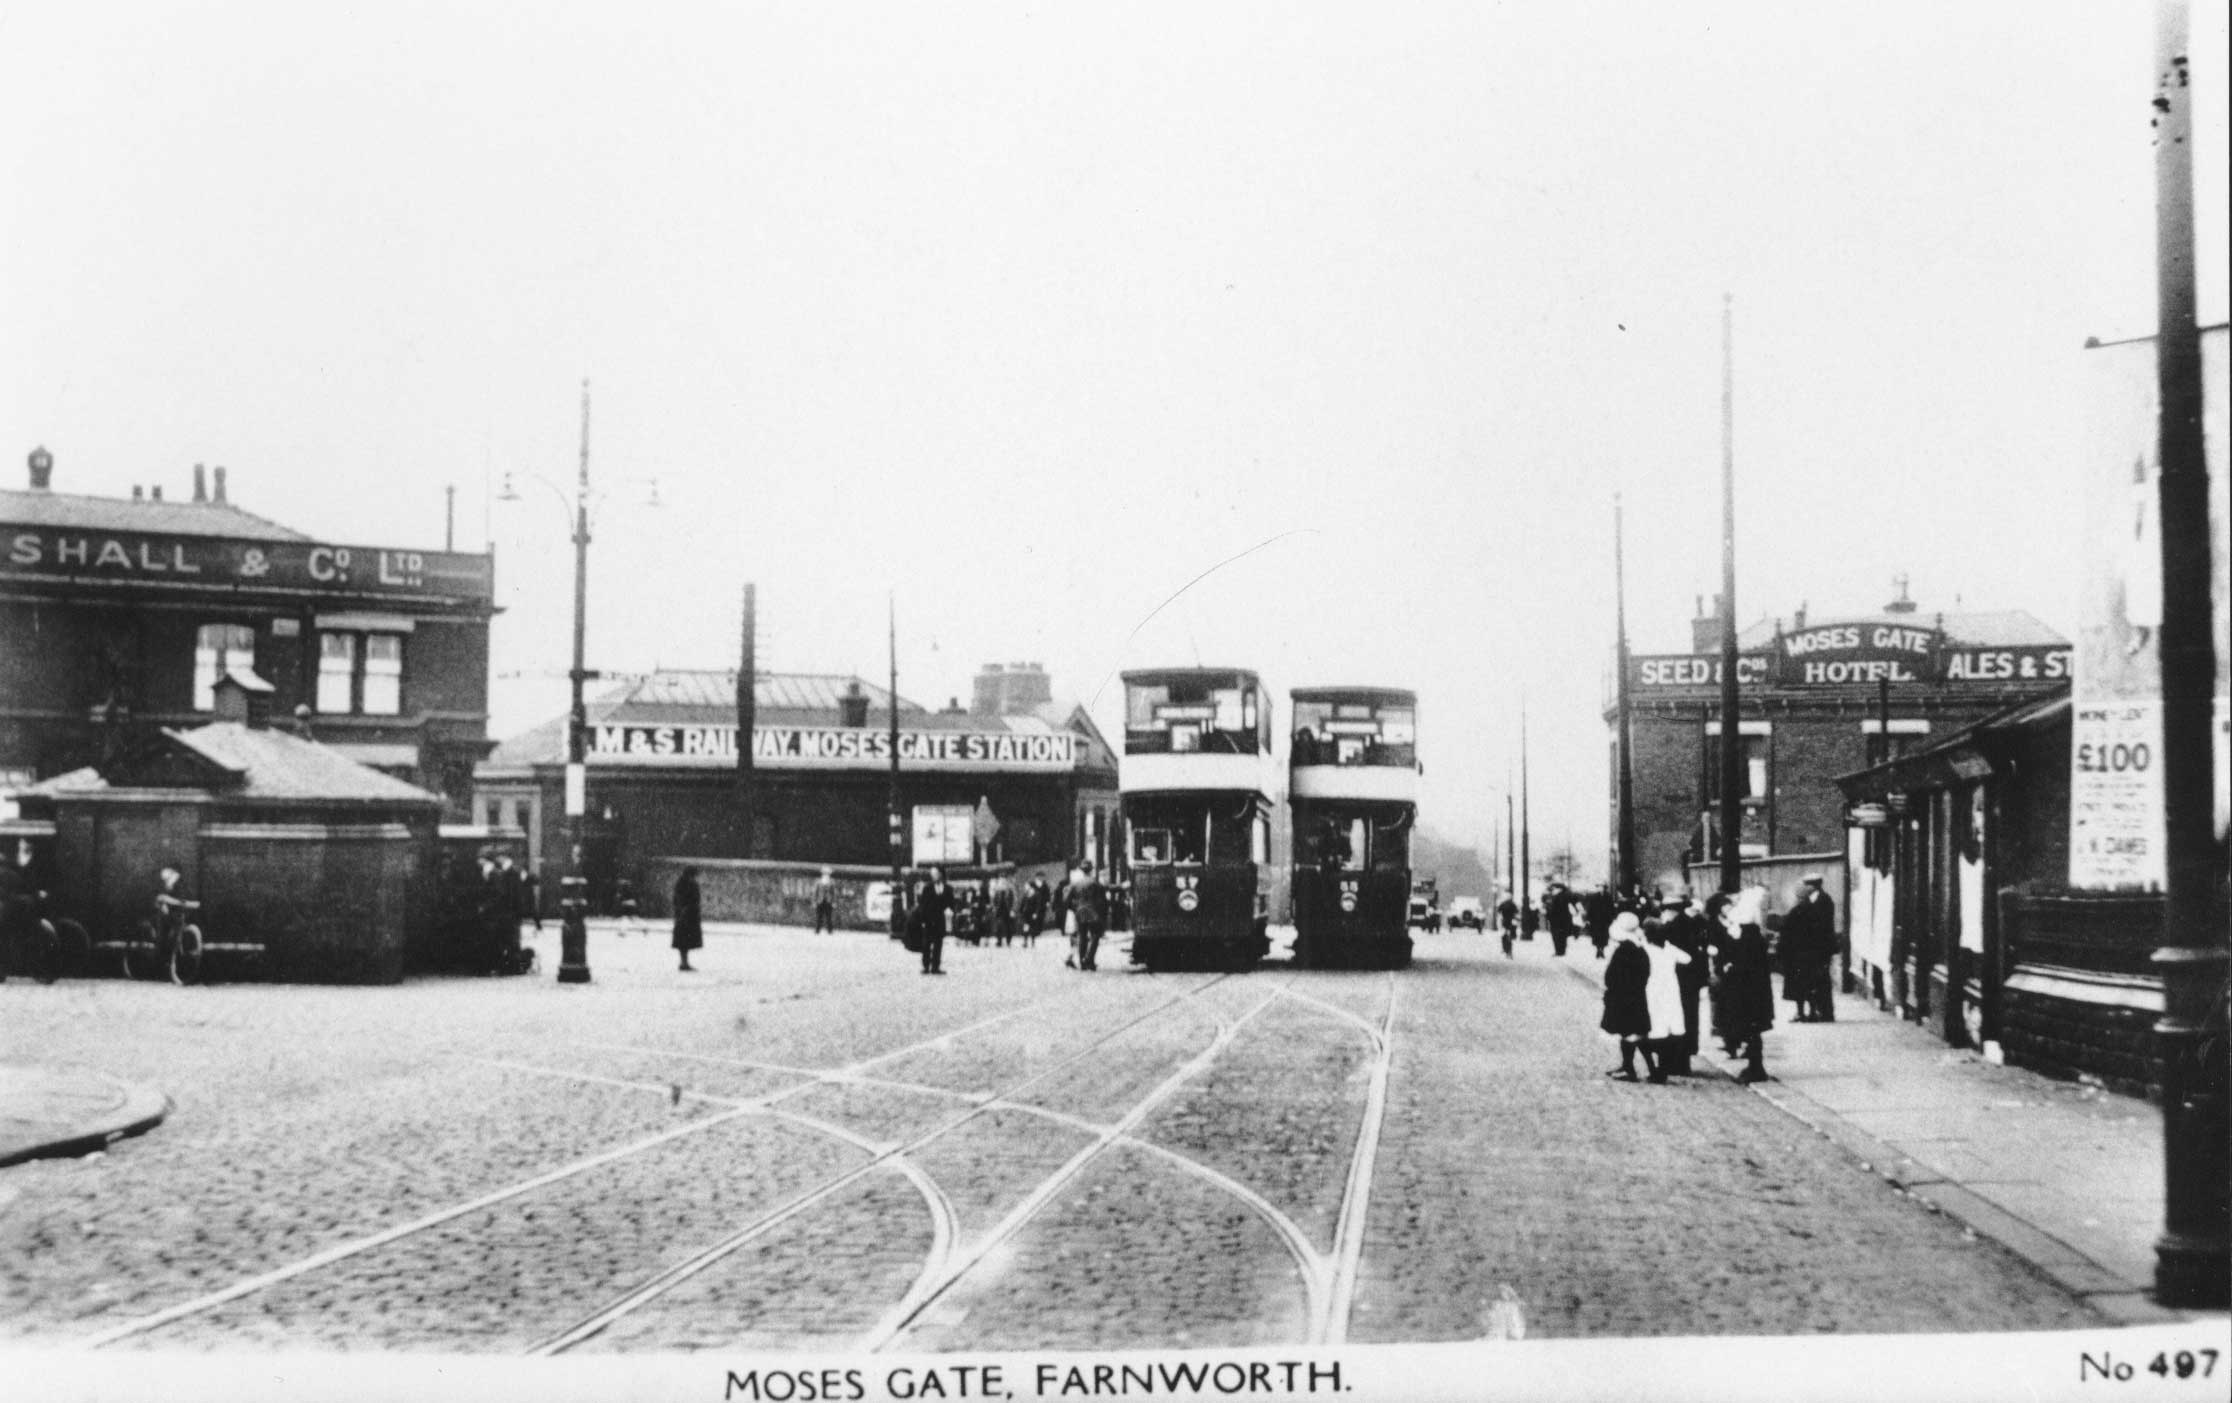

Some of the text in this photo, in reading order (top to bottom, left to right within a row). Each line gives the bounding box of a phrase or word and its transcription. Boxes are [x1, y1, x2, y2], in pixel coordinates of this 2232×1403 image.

[239, 548, 271, 577] &
[1786, 628, 1931, 657] MOSES GATE
[1641, 659, 1711, 685] SEED
[1947, 651, 2015, 679] ALES
[2020, 655, 2038, 679] &
[804, 731, 890, 757] MOSES
[898, 734, 959, 760] GATE
[967, 735, 1063, 761] STATION
[2077, 742, 2151, 773] £100
